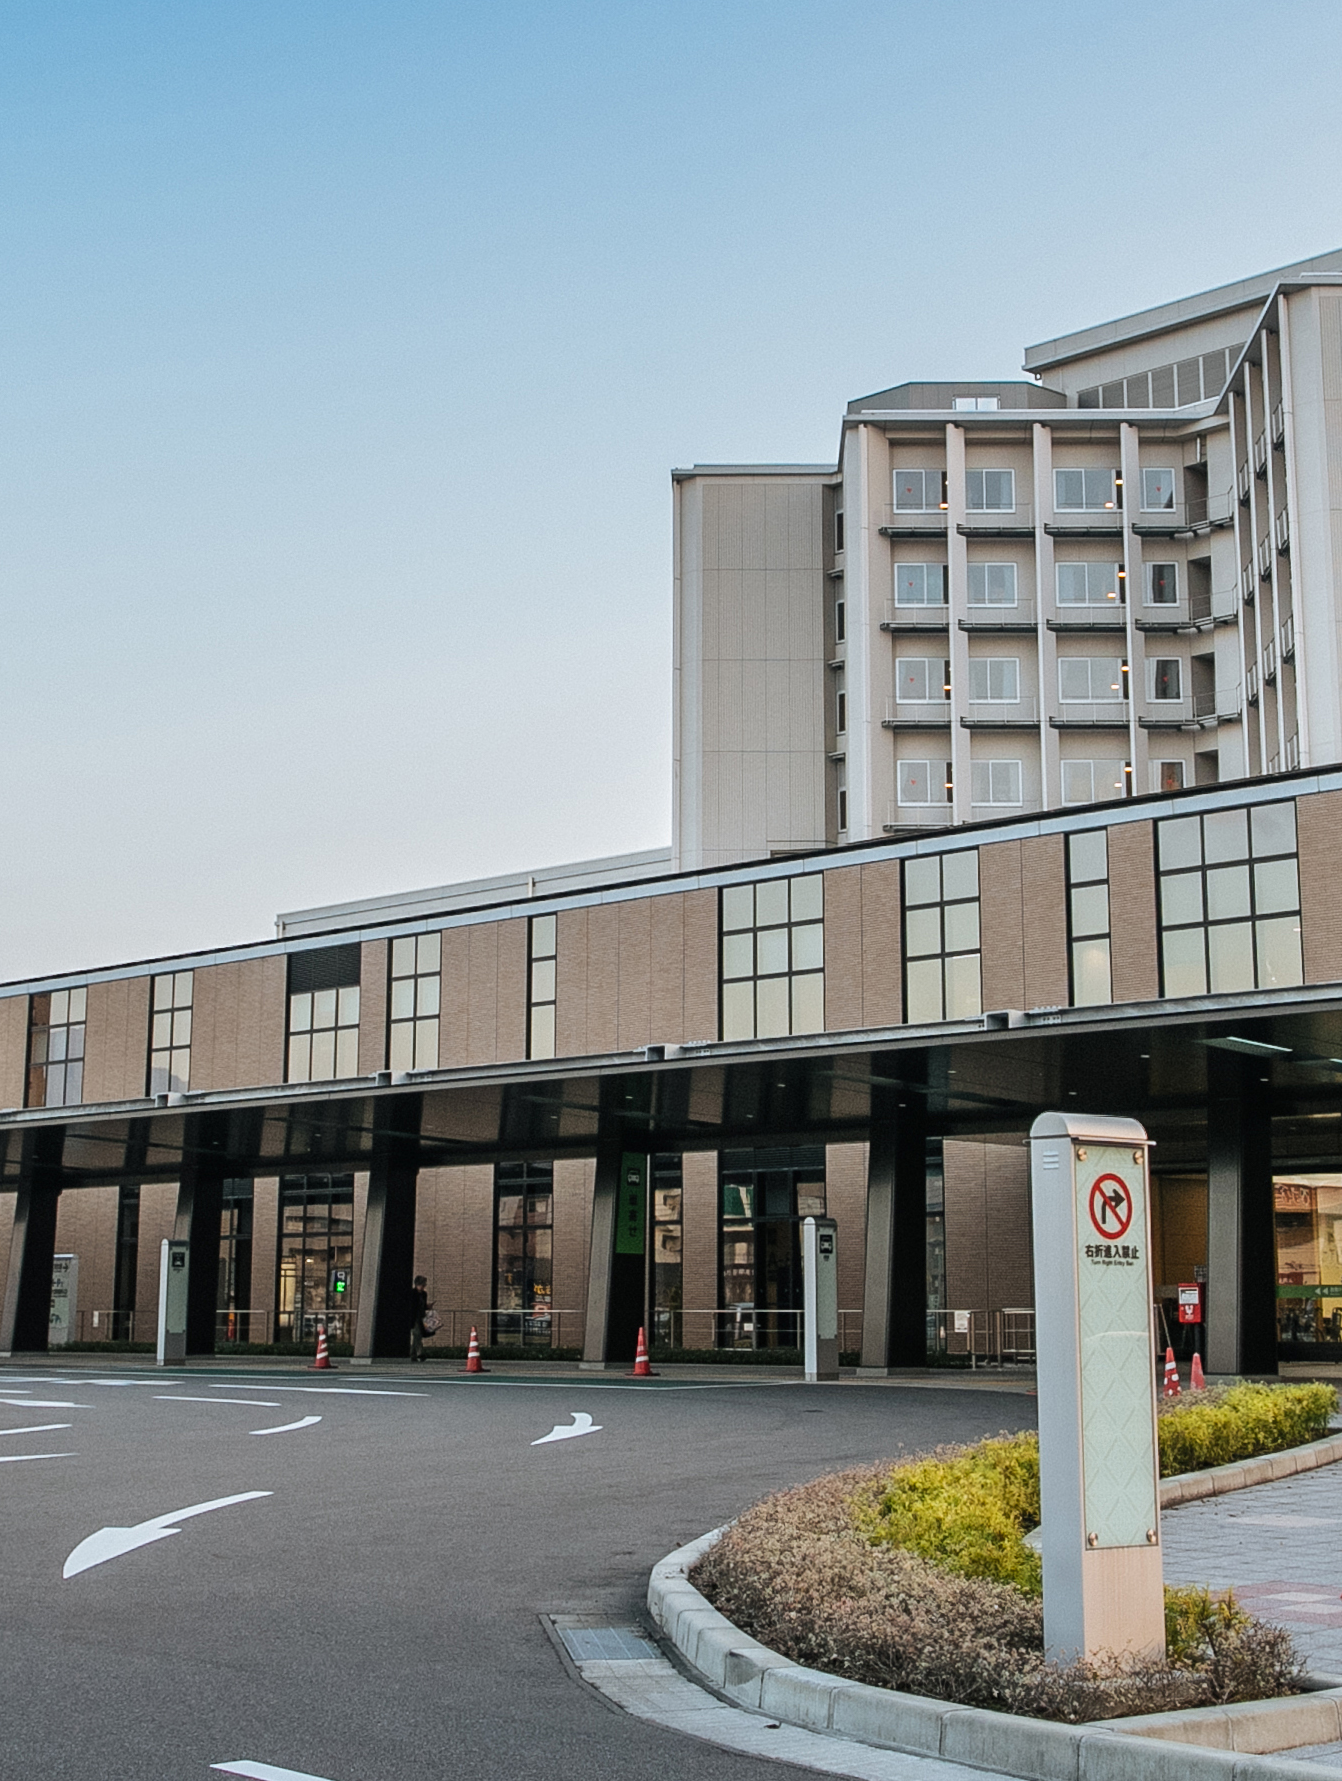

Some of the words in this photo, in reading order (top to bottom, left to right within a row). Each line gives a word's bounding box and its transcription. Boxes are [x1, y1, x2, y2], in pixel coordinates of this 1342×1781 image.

[1085, 1244, 1140, 1260] 右折進入禁止
